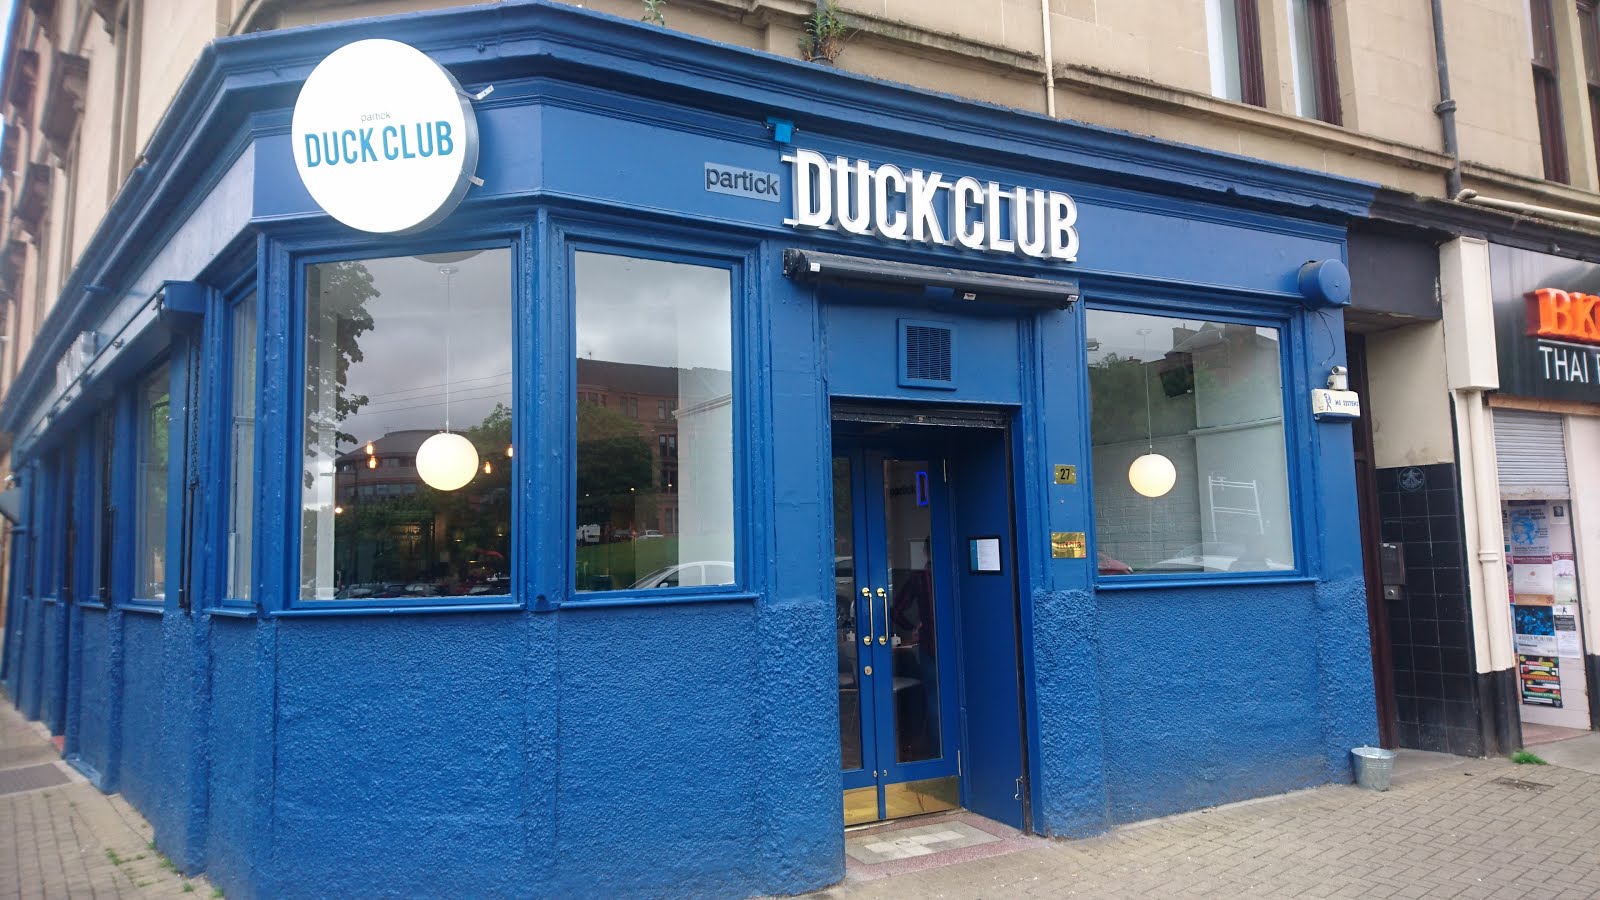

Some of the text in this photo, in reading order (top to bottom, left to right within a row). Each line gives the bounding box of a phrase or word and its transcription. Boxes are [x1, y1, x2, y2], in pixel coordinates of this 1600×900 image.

[361, 112, 391, 123] partick
[304, 120, 454, 168] DUCK CLUB
[706, 168, 779, 196] partick
[796, 148, 1080, 262] DUCK CLUB
[1530, 287, 1600, 341] BK
[1538, 345, 1590, 384] THAI
[1060, 468, 1071, 480] 27
